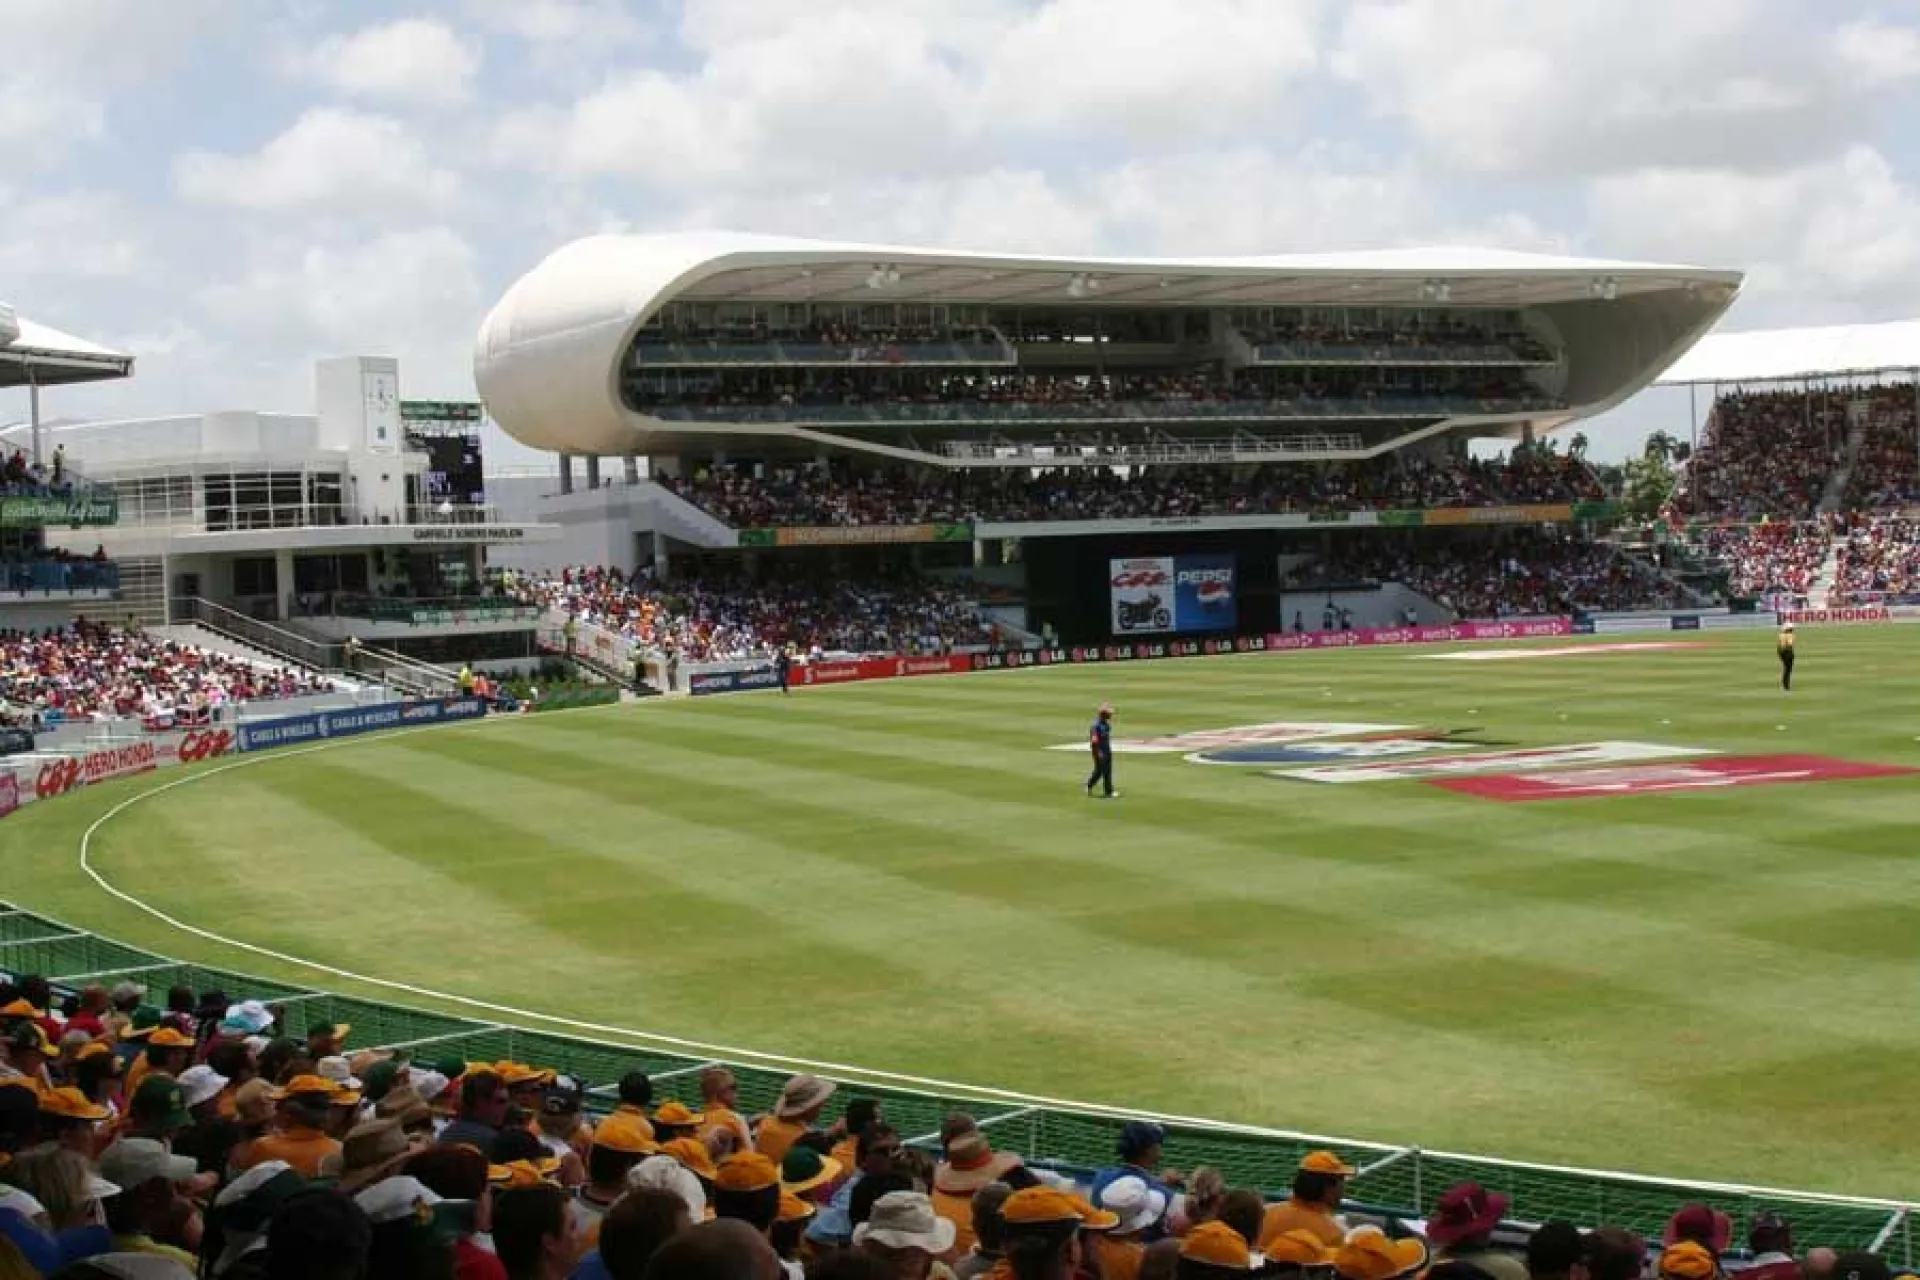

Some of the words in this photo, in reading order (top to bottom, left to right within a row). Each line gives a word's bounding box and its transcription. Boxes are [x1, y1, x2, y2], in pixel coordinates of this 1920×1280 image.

[1178, 568, 1232, 584] PEPSI
[1782, 611, 1827, 622] HERO
[1832, 608, 1889, 620] HONDA
[85, 750, 117, 776] HERO
[119, 740, 155, 768] HONDA
